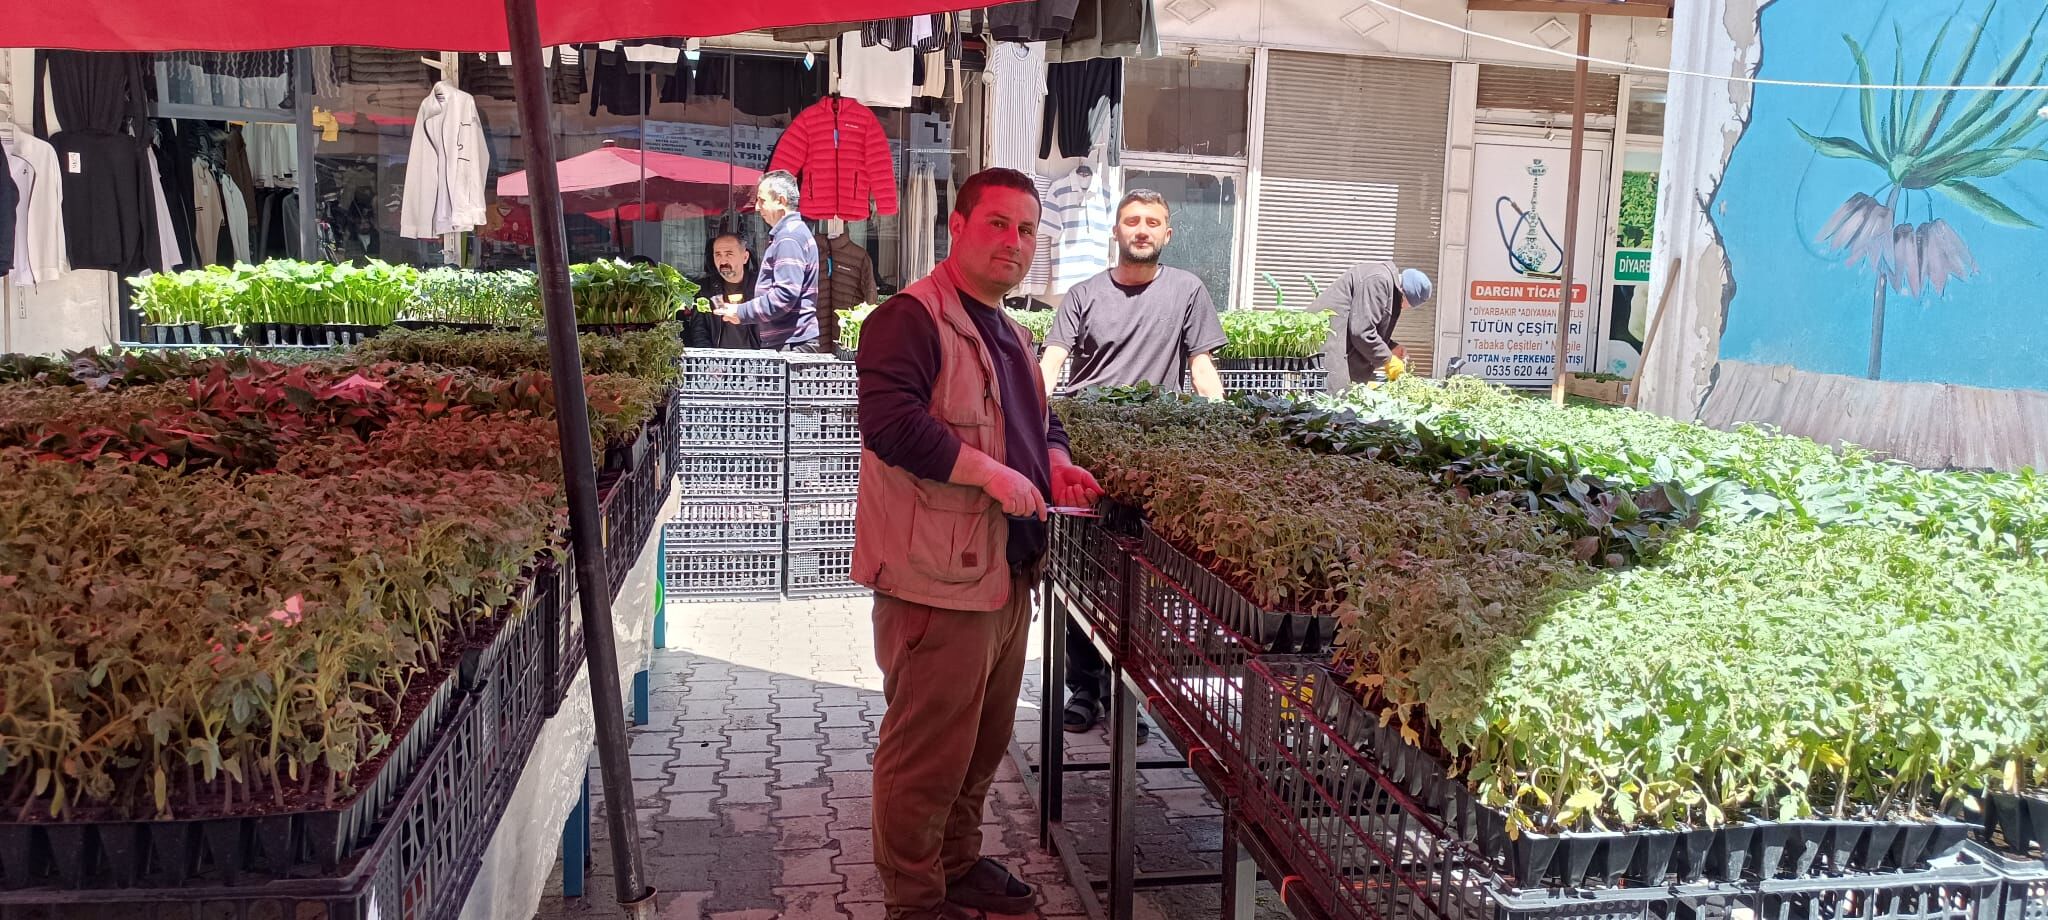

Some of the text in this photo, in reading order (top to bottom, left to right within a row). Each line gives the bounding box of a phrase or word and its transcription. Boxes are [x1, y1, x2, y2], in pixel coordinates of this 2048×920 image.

[1475, 285, 1580, 299] DARGIN TİCART
[1473, 306, 1517, 316] DİYARBAKIR
[1470, 319, 1581, 336] TÜTÜN ÇEŞİTLRİ
[1474, 339, 1581, 353] Tabaka Çeşitleri Ngile
[1467, 354, 1499, 363] TOPTAN
[1513, 354, 1556, 363] PERKENDE
[1486, 365, 1511, 376] 0535
[1514, 365, 1532, 376] 620
[1535, 366, 1548, 377] 44
